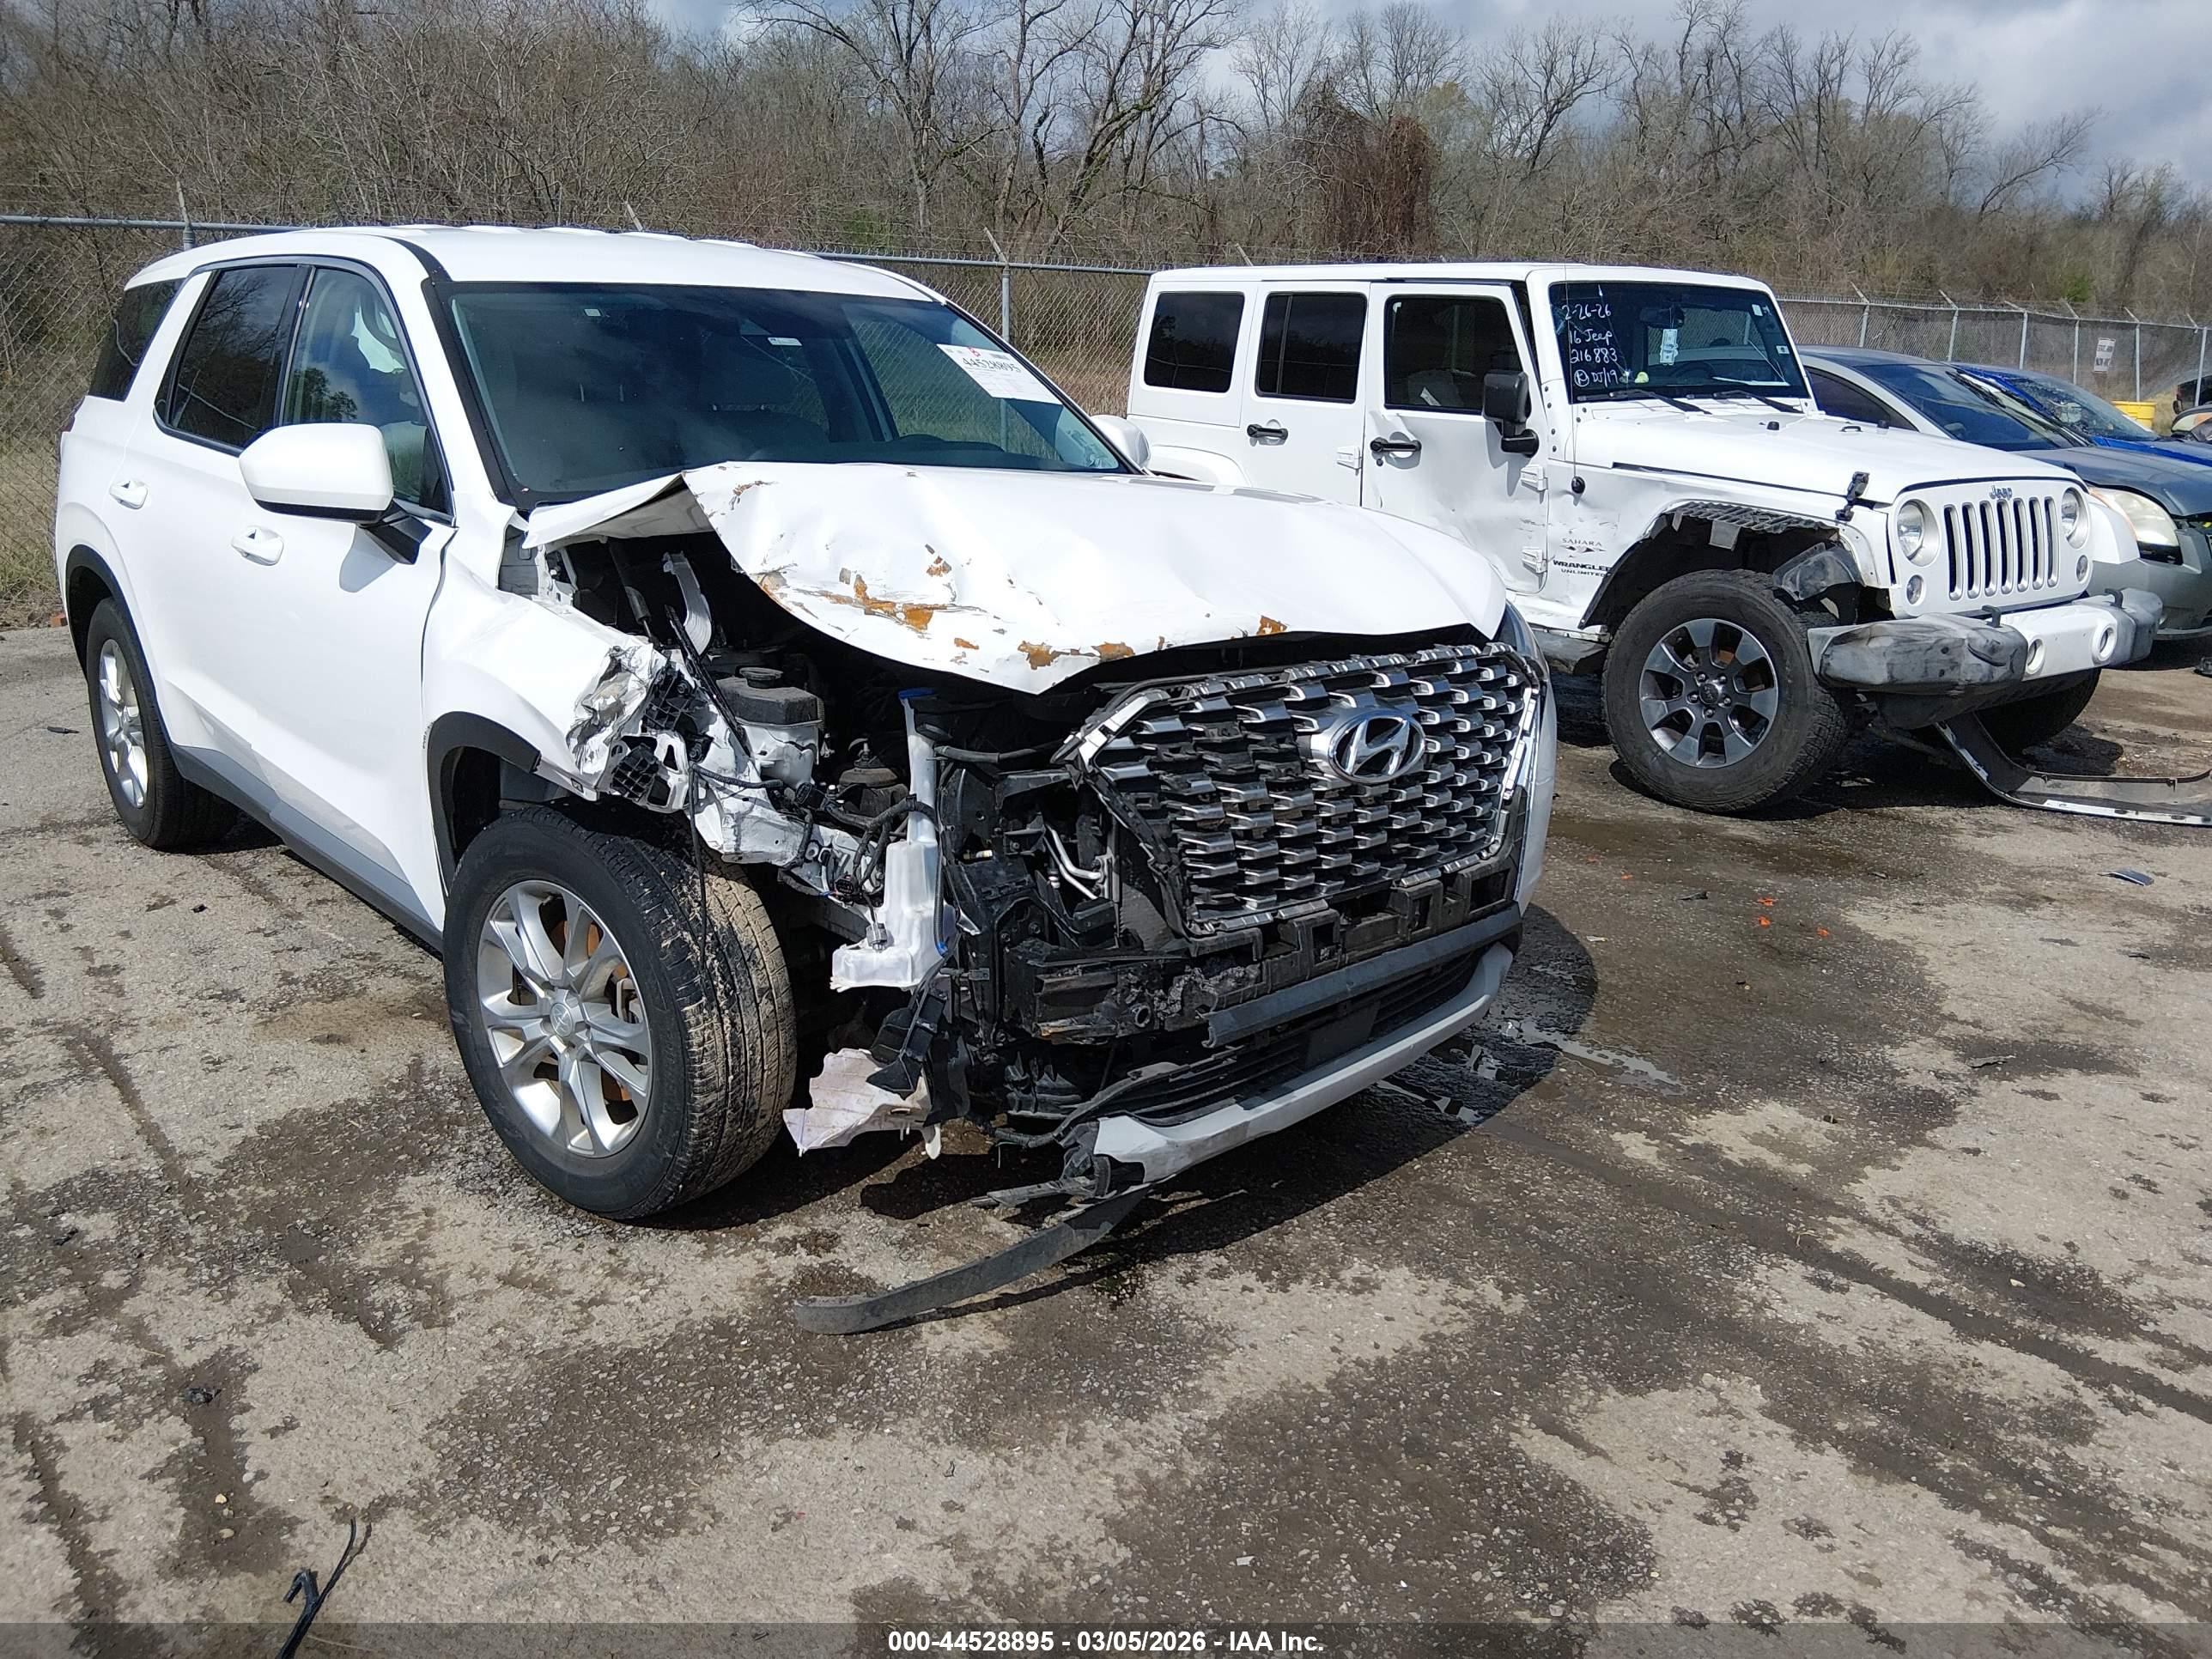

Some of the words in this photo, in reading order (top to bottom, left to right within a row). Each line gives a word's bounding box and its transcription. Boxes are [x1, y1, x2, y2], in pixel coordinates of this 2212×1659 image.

[1562, 304, 1611, 320] 2-26-26
[1569, 330, 1582, 344] 16
[1584, 328, 1613, 345] Jeep
[1989, 484, 2013, 501] Jeep
[1562, 538, 1602, 547] SAHARA
